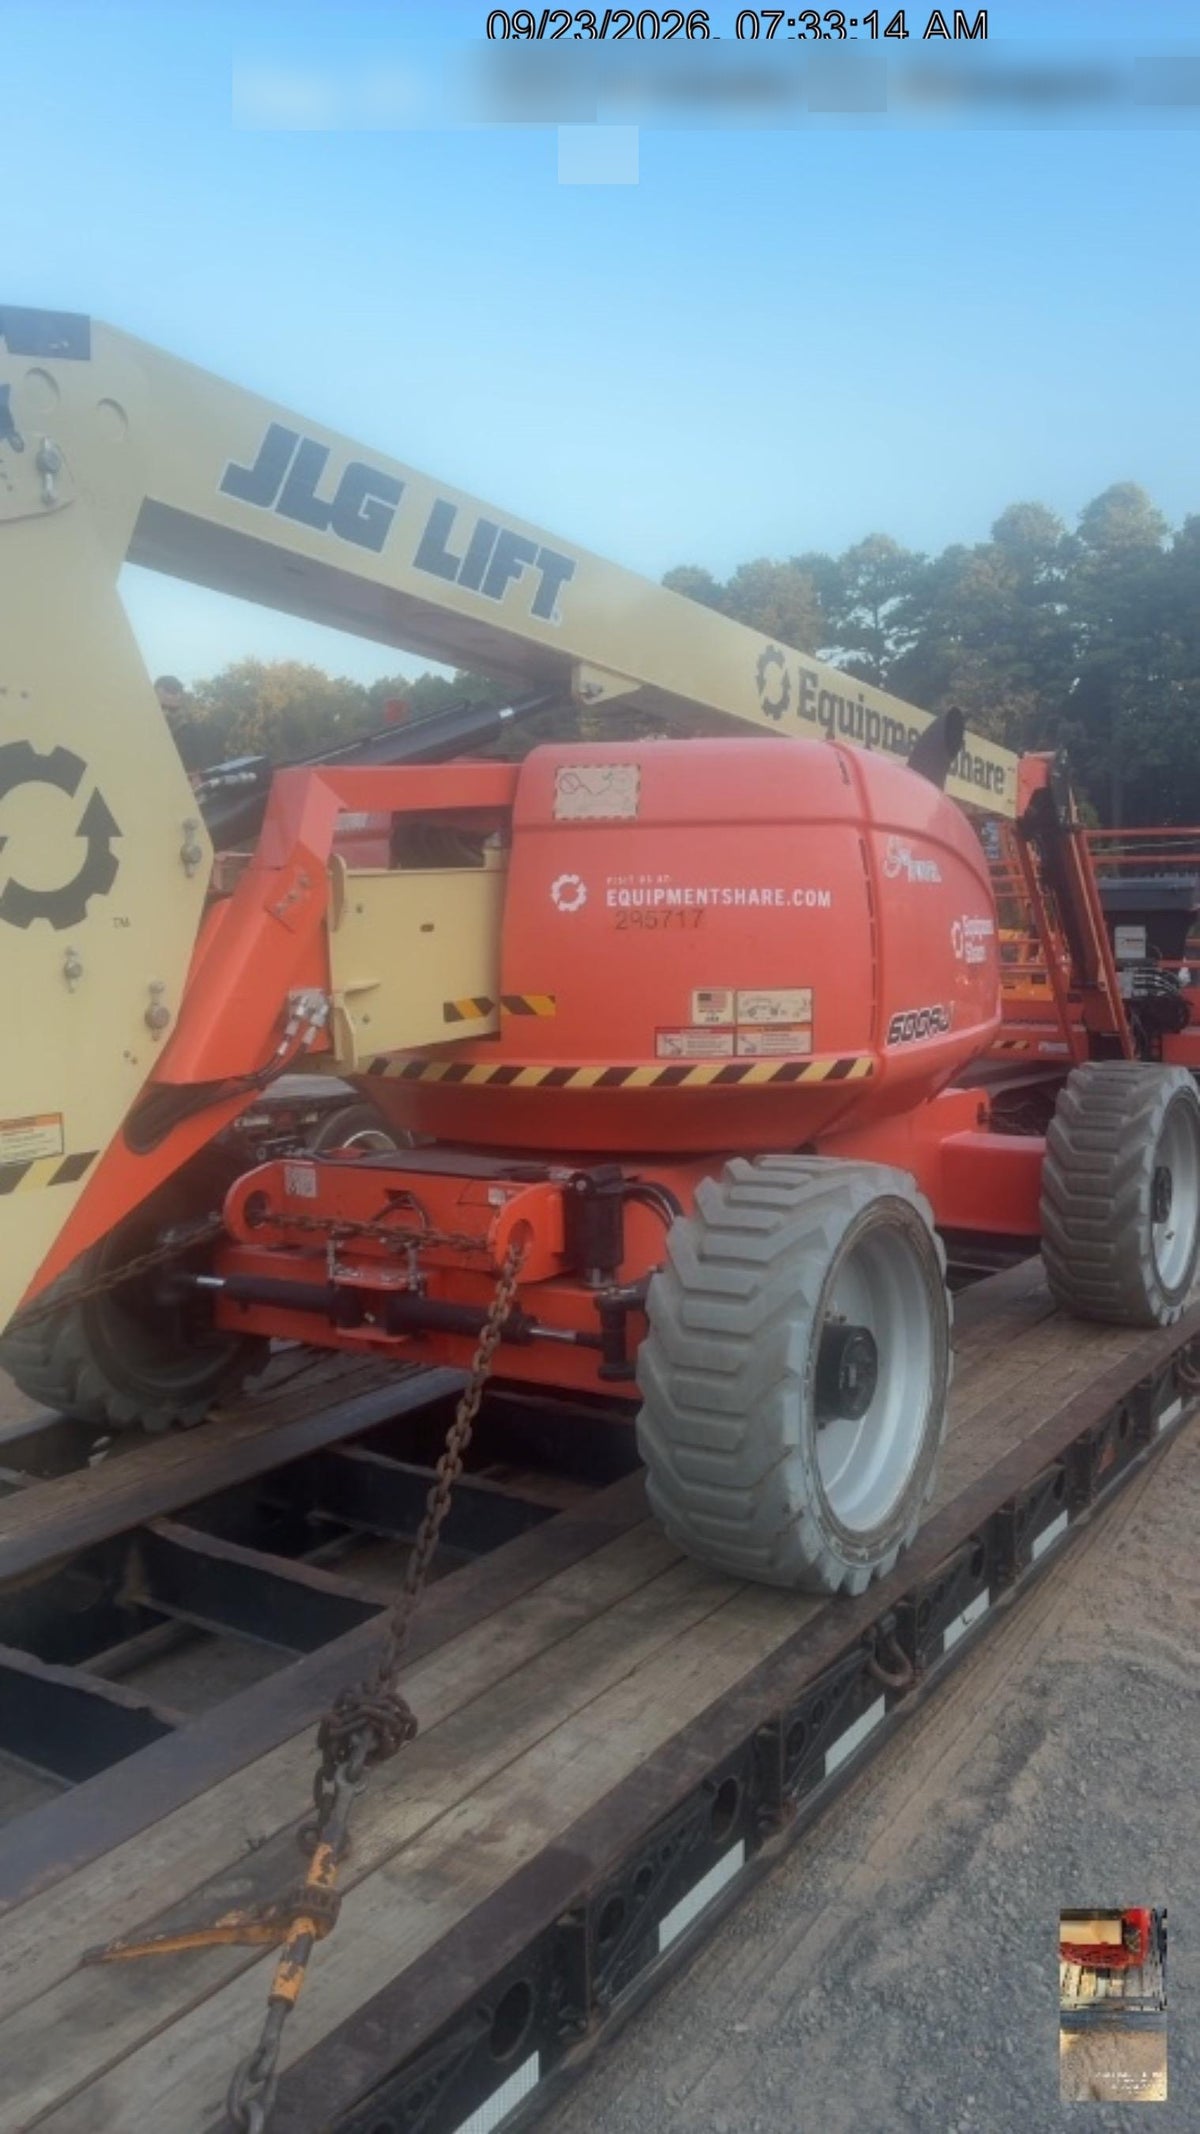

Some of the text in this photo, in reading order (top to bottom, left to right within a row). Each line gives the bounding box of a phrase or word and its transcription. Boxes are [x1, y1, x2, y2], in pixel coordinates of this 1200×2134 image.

[218, 421, 577, 624] JLG LIFT
[605, 887, 833, 908] EQUIPMENTSHARE.COM
[614, 908, 704, 931] 295717
